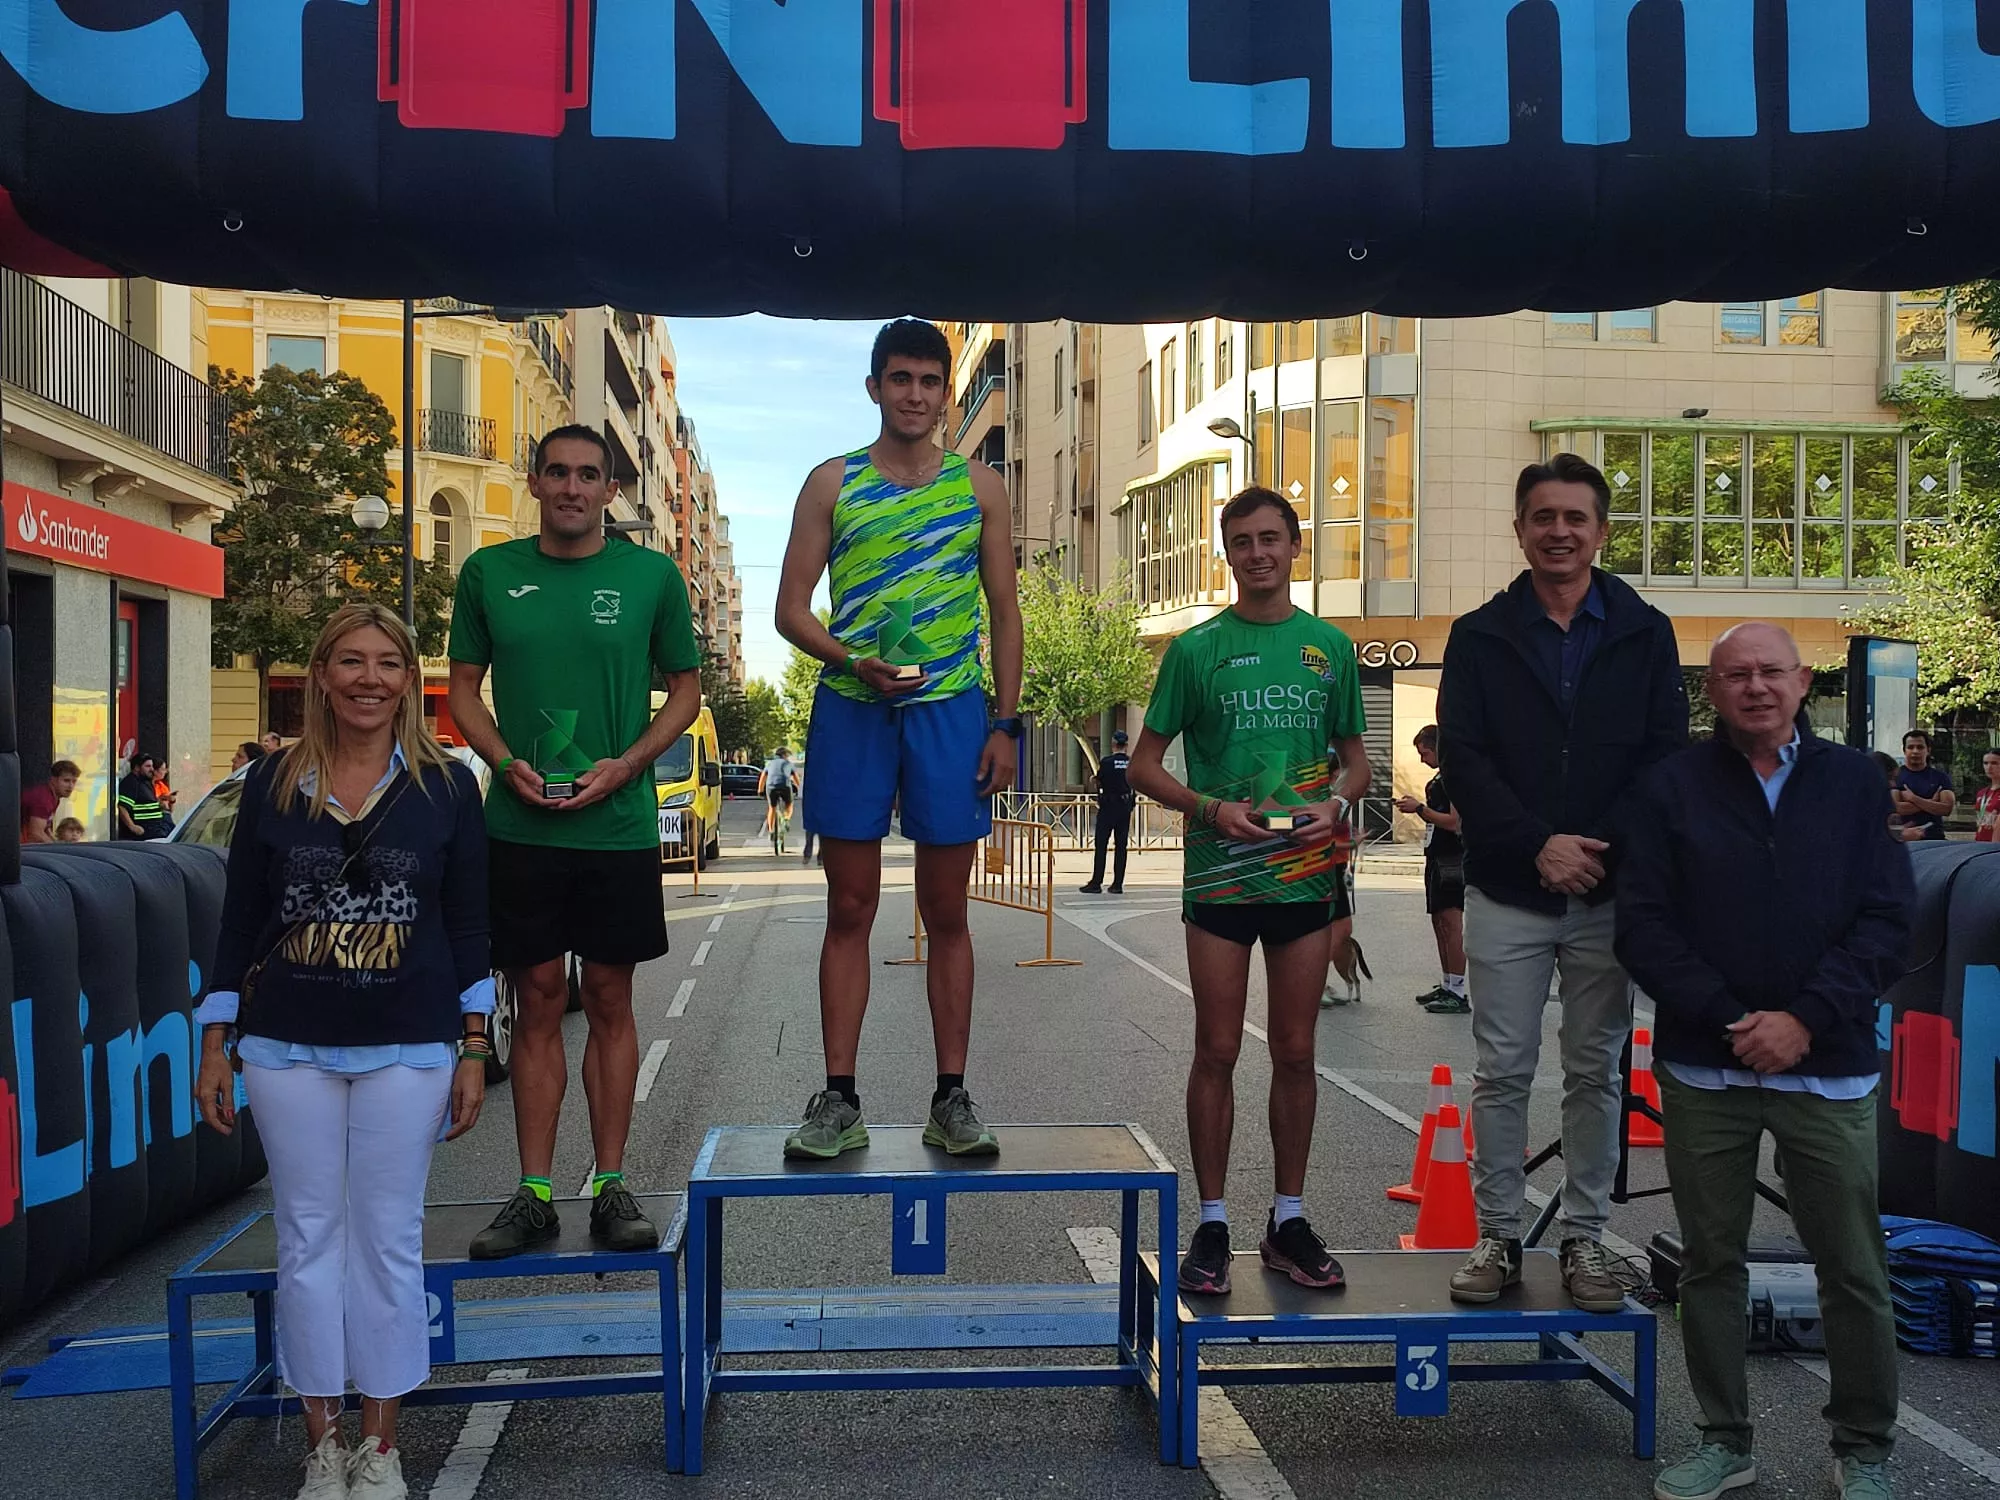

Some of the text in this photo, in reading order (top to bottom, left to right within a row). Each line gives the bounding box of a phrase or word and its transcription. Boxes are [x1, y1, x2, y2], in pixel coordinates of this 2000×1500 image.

[40, 509, 110, 560] Santander
[658, 815, 681, 835] 10K
[905, 1199, 931, 1246] 1
[425, 1291, 444, 1338] 2
[1405, 1345, 1440, 1391] 3
